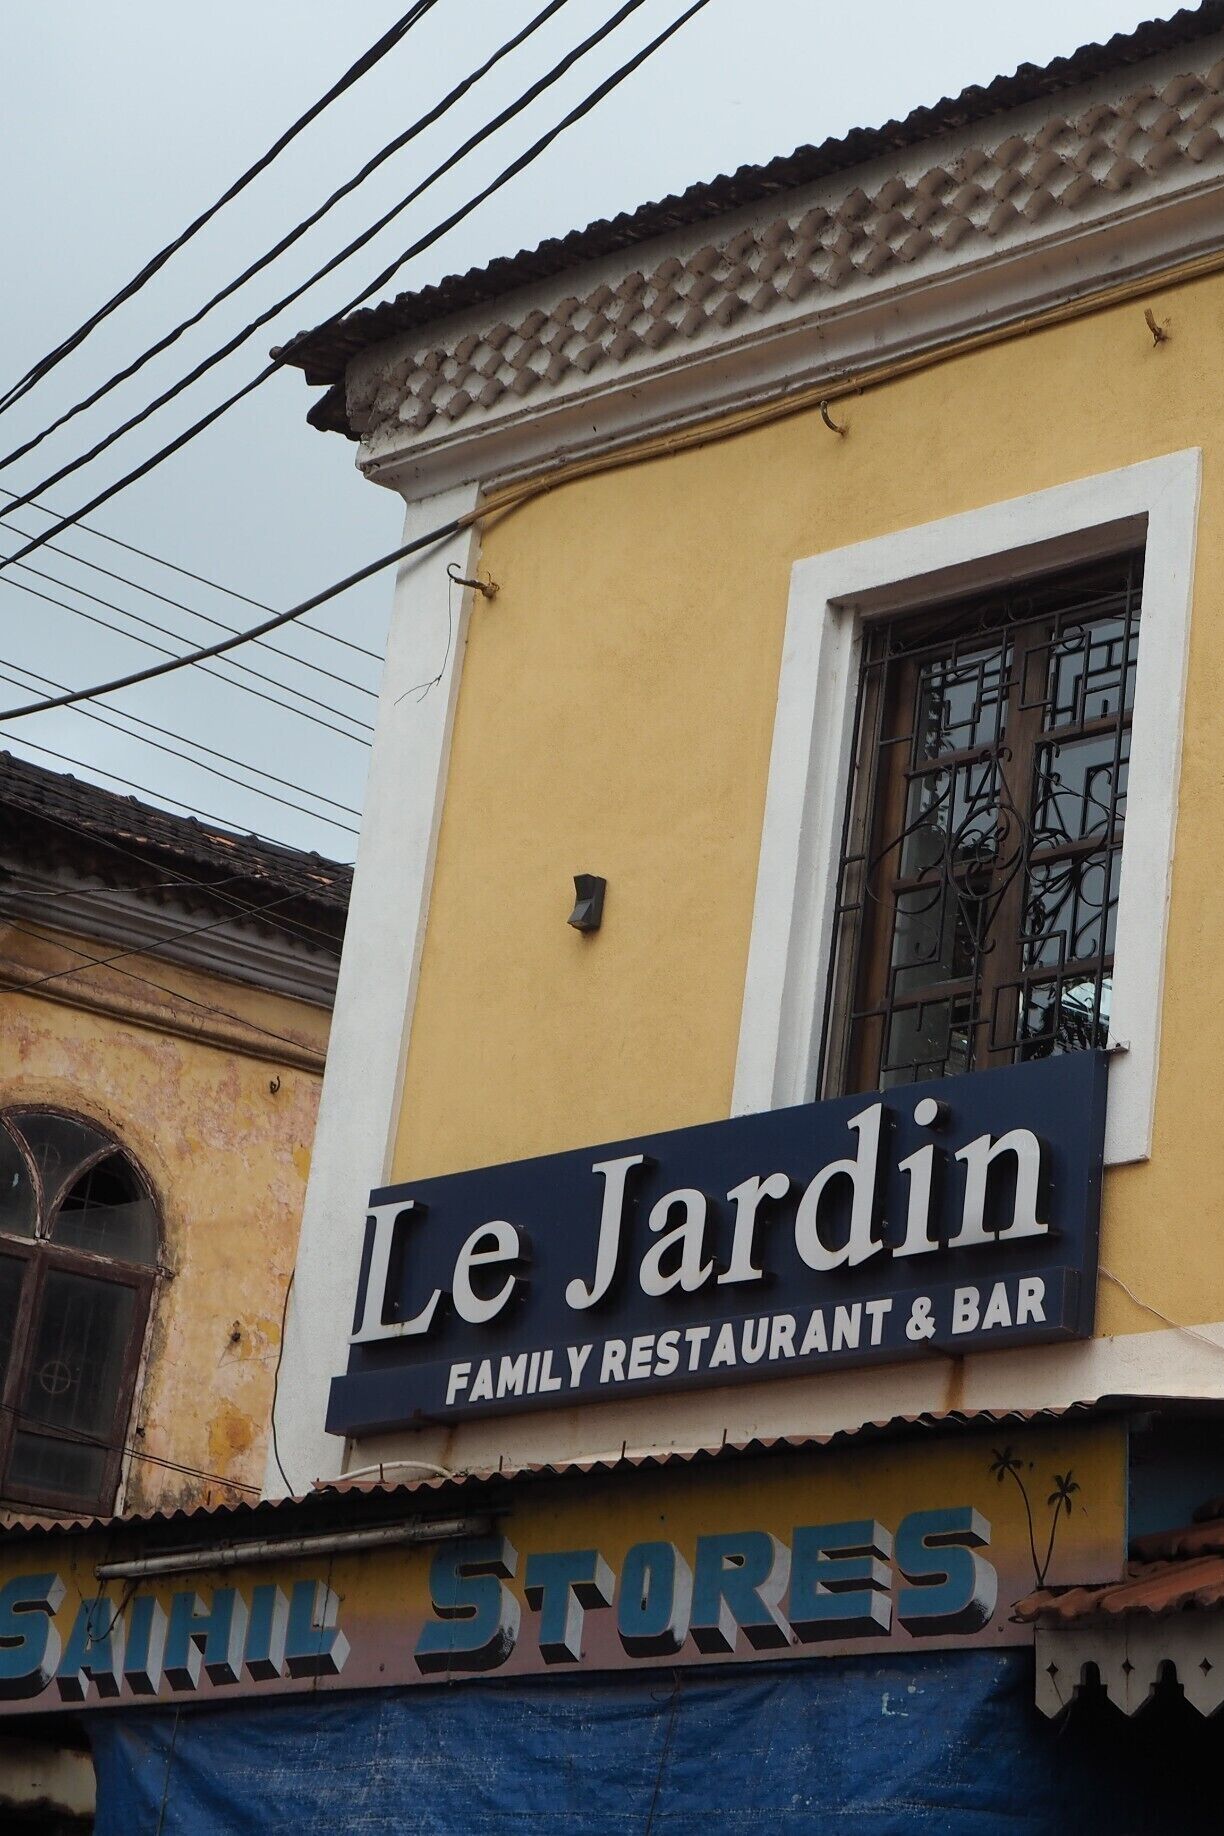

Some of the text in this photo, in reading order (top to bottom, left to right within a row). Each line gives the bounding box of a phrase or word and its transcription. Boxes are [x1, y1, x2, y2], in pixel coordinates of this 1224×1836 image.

[349, 1098, 1050, 1346] Le Jardin
[445, 1276, 1048, 1405] FAMILY RESTAURANT & BAR
[413, 1506, 998, 1675] STORES
